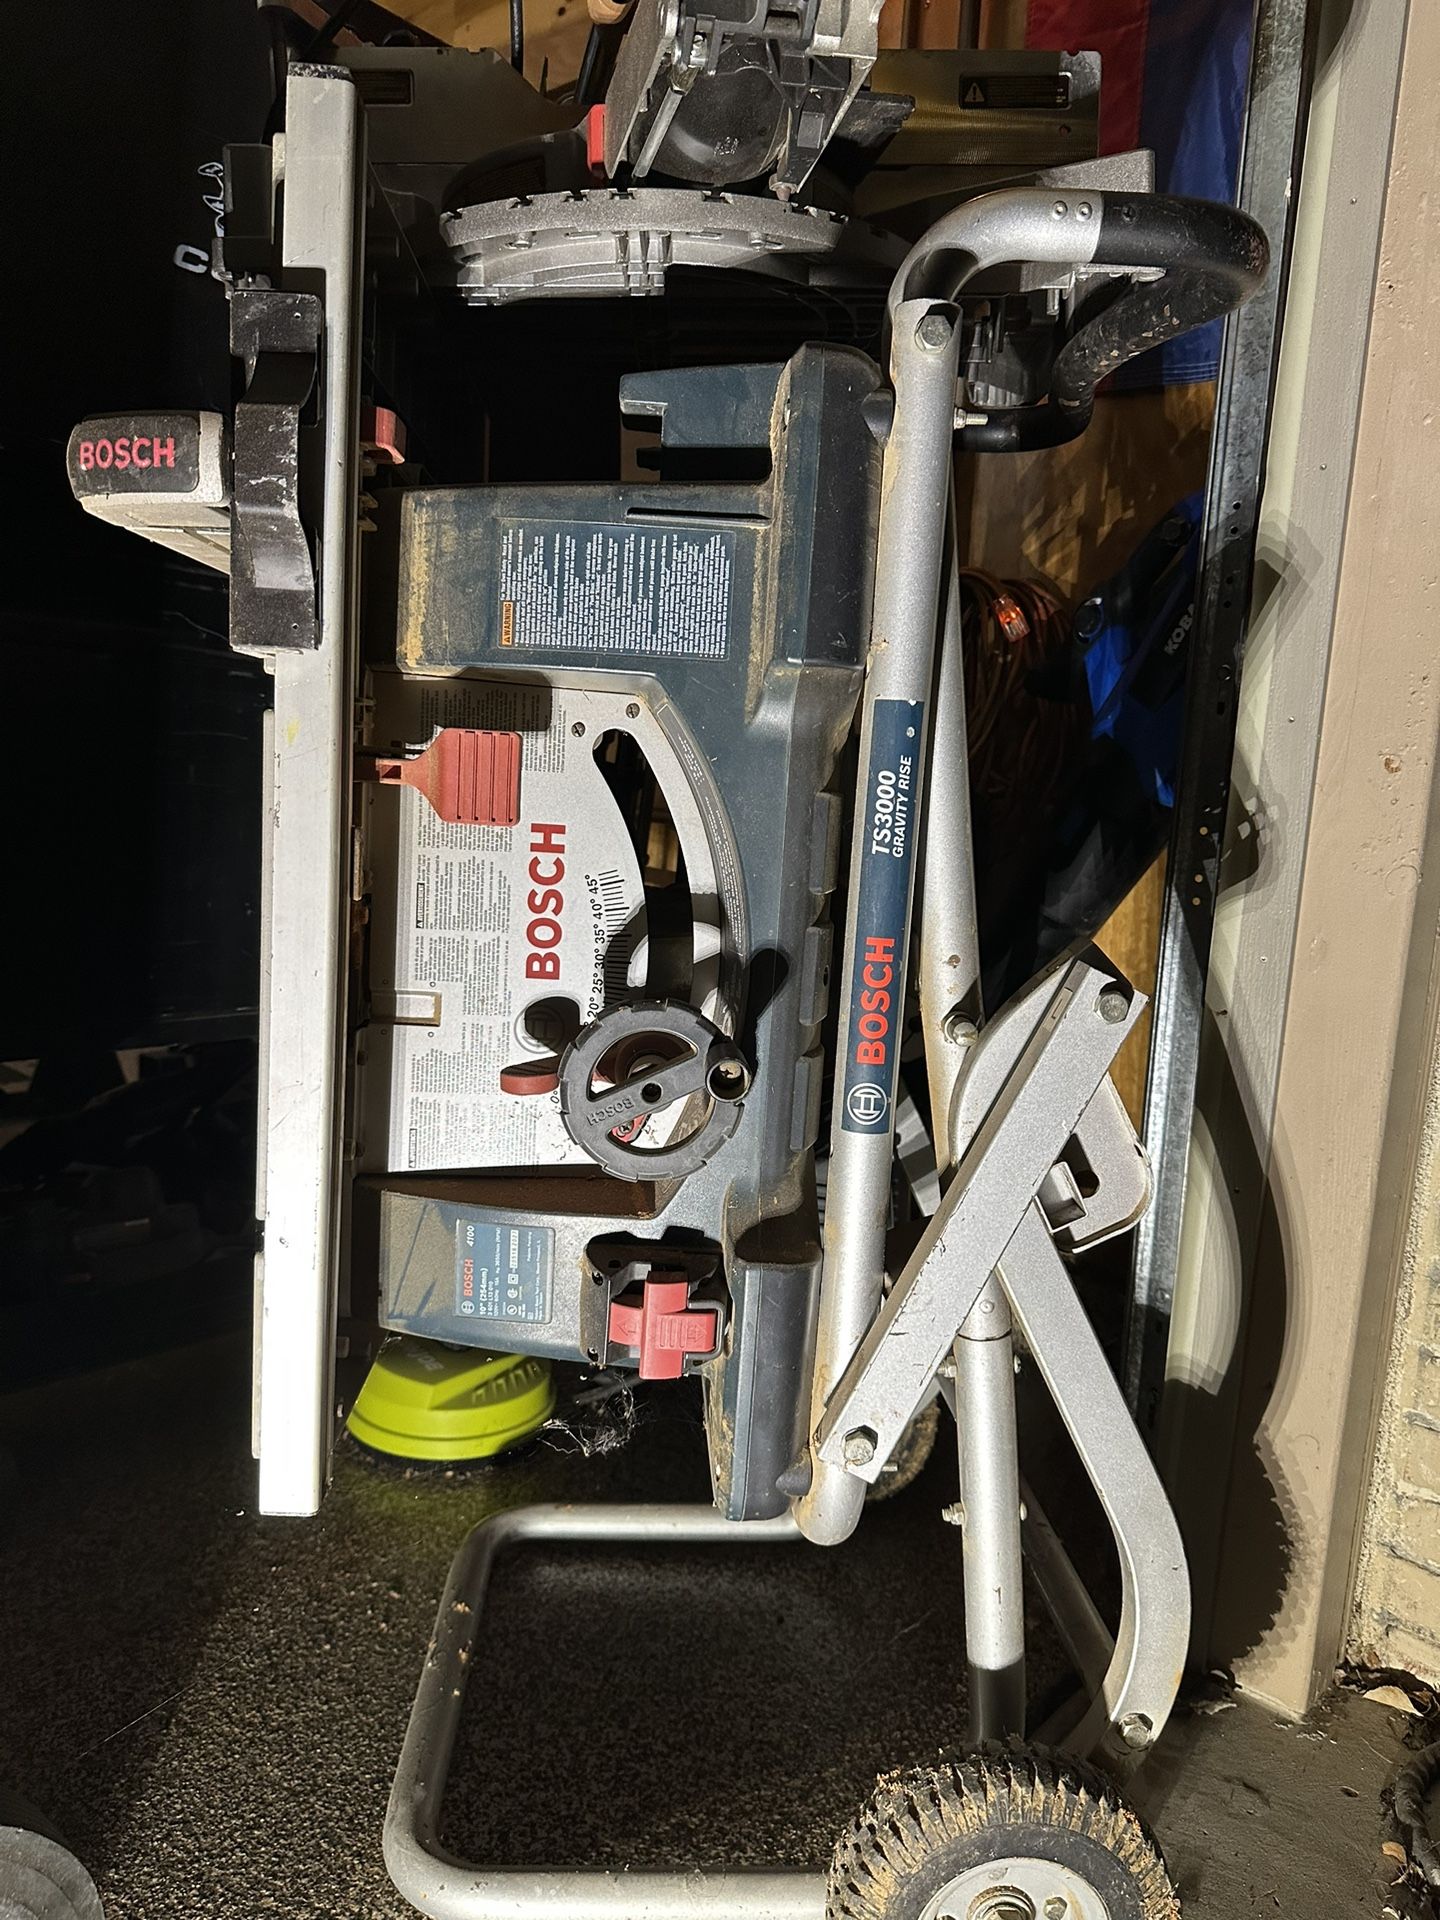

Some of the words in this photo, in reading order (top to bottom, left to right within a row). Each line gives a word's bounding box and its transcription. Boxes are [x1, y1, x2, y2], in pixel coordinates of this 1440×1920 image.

[79, 437, 176, 471] BOSCH
[503, 603, 512, 636] WARNING
[897, 754, 912, 790] RISE
[872, 769, 897, 856] TS3000
[893, 792, 910, 858] GRAVITY
[584, 874, 598, 894] 45°
[525, 823, 566, 980] BOSCH
[590, 898, 603, 920] 40°
[593, 923, 605, 944] 35°
[594, 948, 605, 969] 30°
[592, 973, 604, 994] 25°
[587, 996, 599, 1017] 20°
[856, 936, 895, 1066] BOSCH
[585, 1095, 635, 1126] BOSCH
[463, 1258, 473, 1296] BOSCH
[480, 1268, 488, 1301] (254mm)
